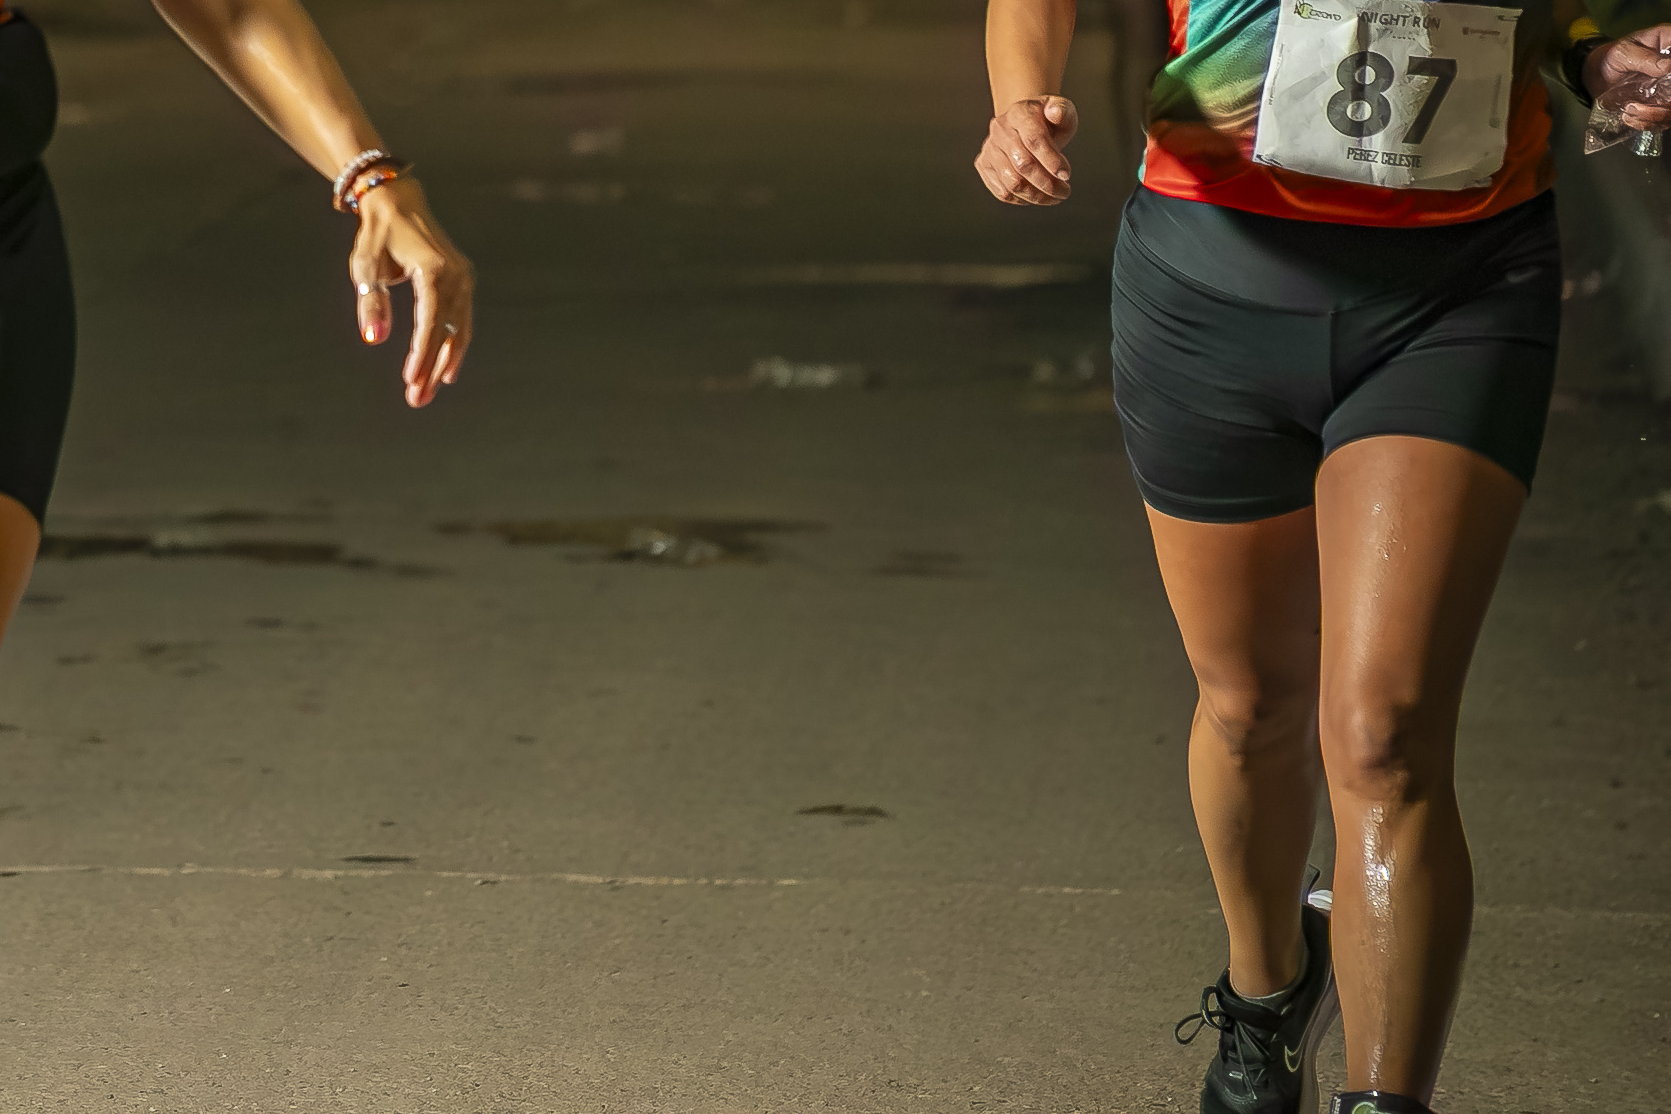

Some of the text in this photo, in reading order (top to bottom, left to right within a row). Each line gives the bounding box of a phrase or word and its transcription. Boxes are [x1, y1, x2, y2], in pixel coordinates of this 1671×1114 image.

[1358, 11, 1408, 29] NIGHT
[1327, 50, 1458, 145] 87
[1347, 146, 1424, 169] PEREZ CELESTE
